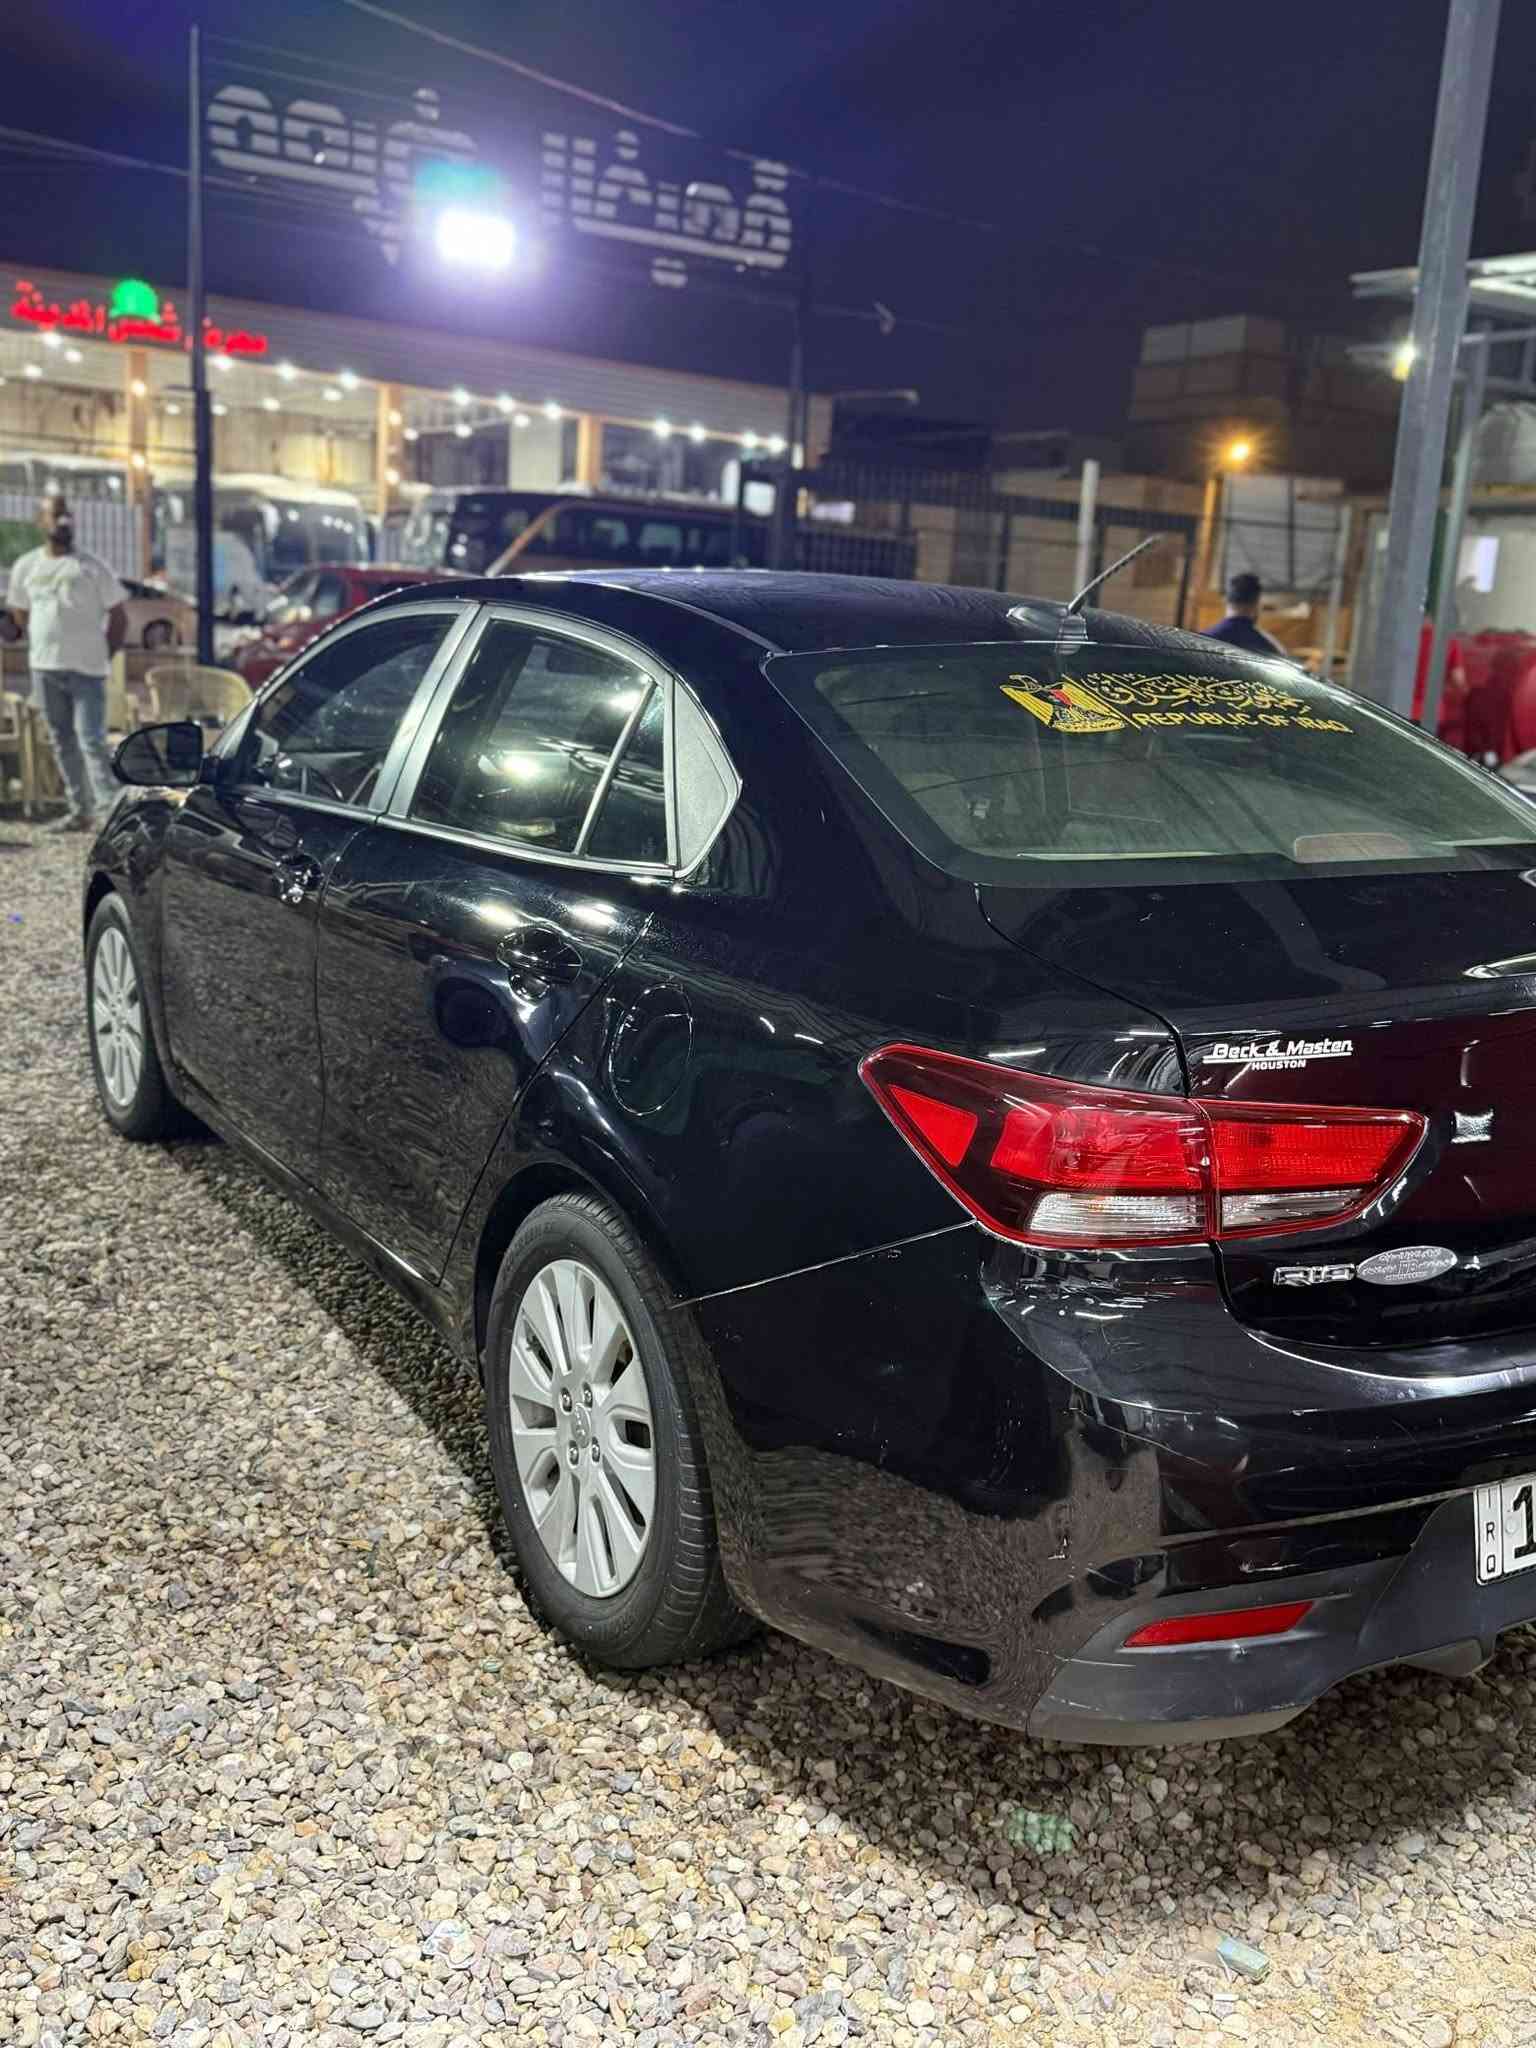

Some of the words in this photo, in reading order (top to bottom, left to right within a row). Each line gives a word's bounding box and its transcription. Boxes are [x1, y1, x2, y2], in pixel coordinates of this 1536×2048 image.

[1131, 711, 1258, 727] REPUBLIC
[1258, 714, 1291, 727] OF
[1291, 716, 1353, 734] IRAQ
[1211, 1042, 1264, 1059] Beck
[1265, 1039, 1286, 1057] &
[1286, 1038, 1354, 1056] Masten
[1251, 1059, 1306, 1071] HOUSTON
